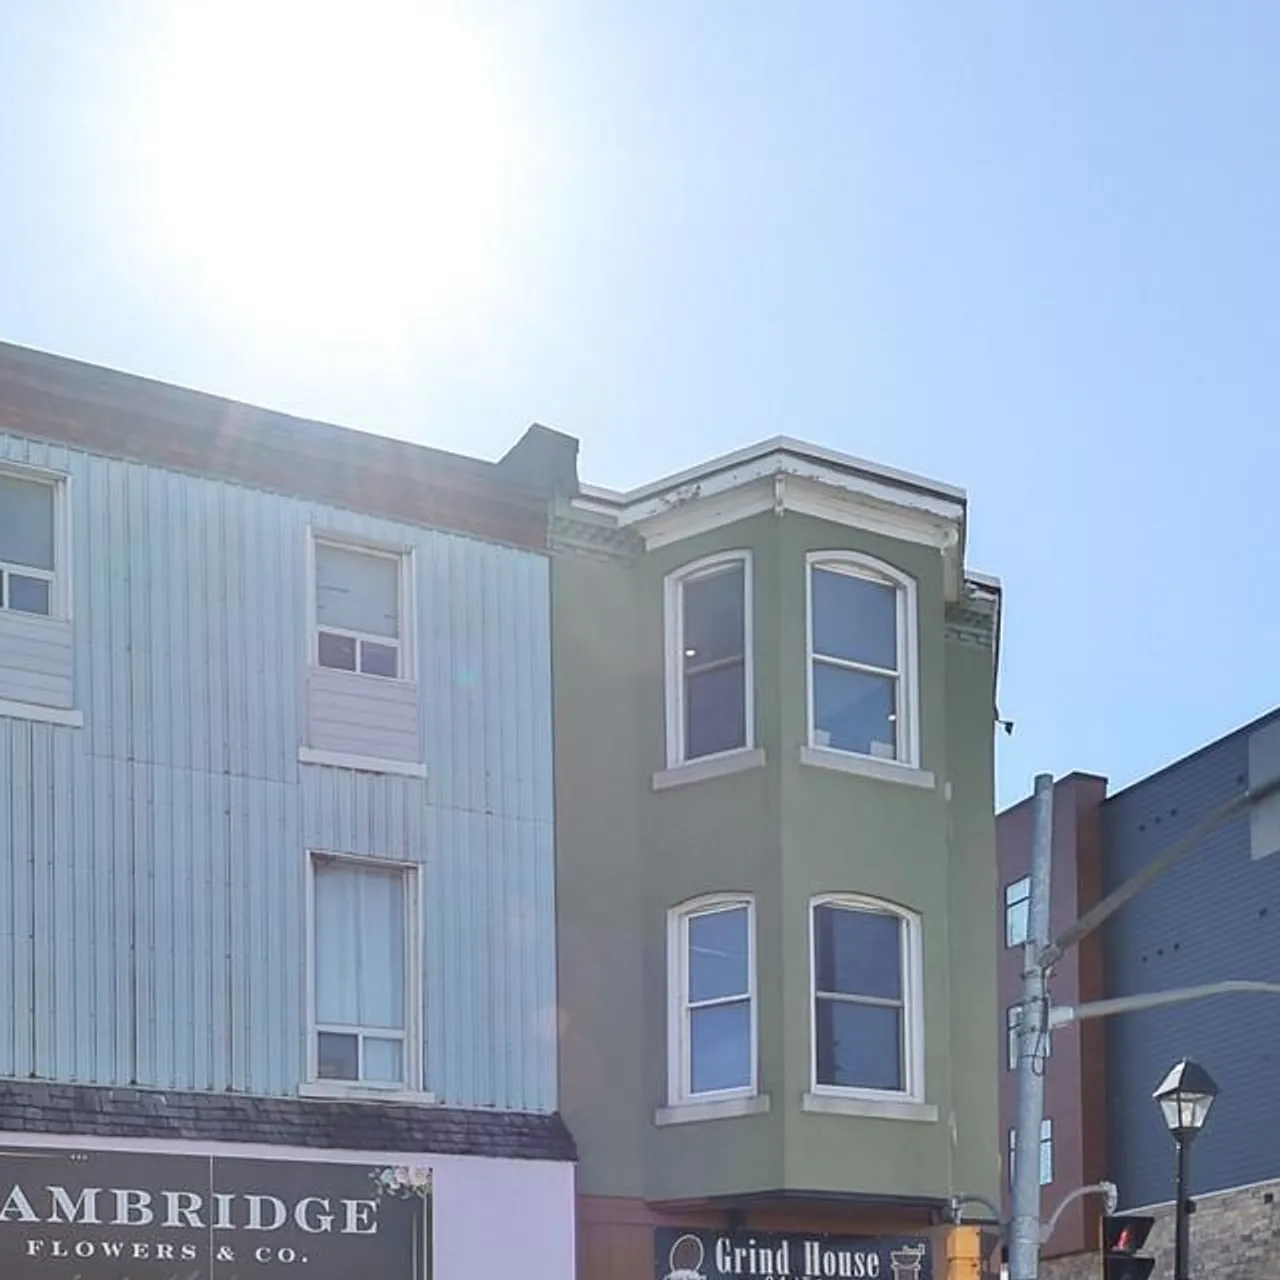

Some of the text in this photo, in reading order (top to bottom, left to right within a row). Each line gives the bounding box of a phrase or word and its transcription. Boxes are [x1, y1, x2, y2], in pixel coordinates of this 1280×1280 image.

[26, 1239, 309, 1265] FLOWERS & CO.
[715, 1237, 880, 1278] Grind House
